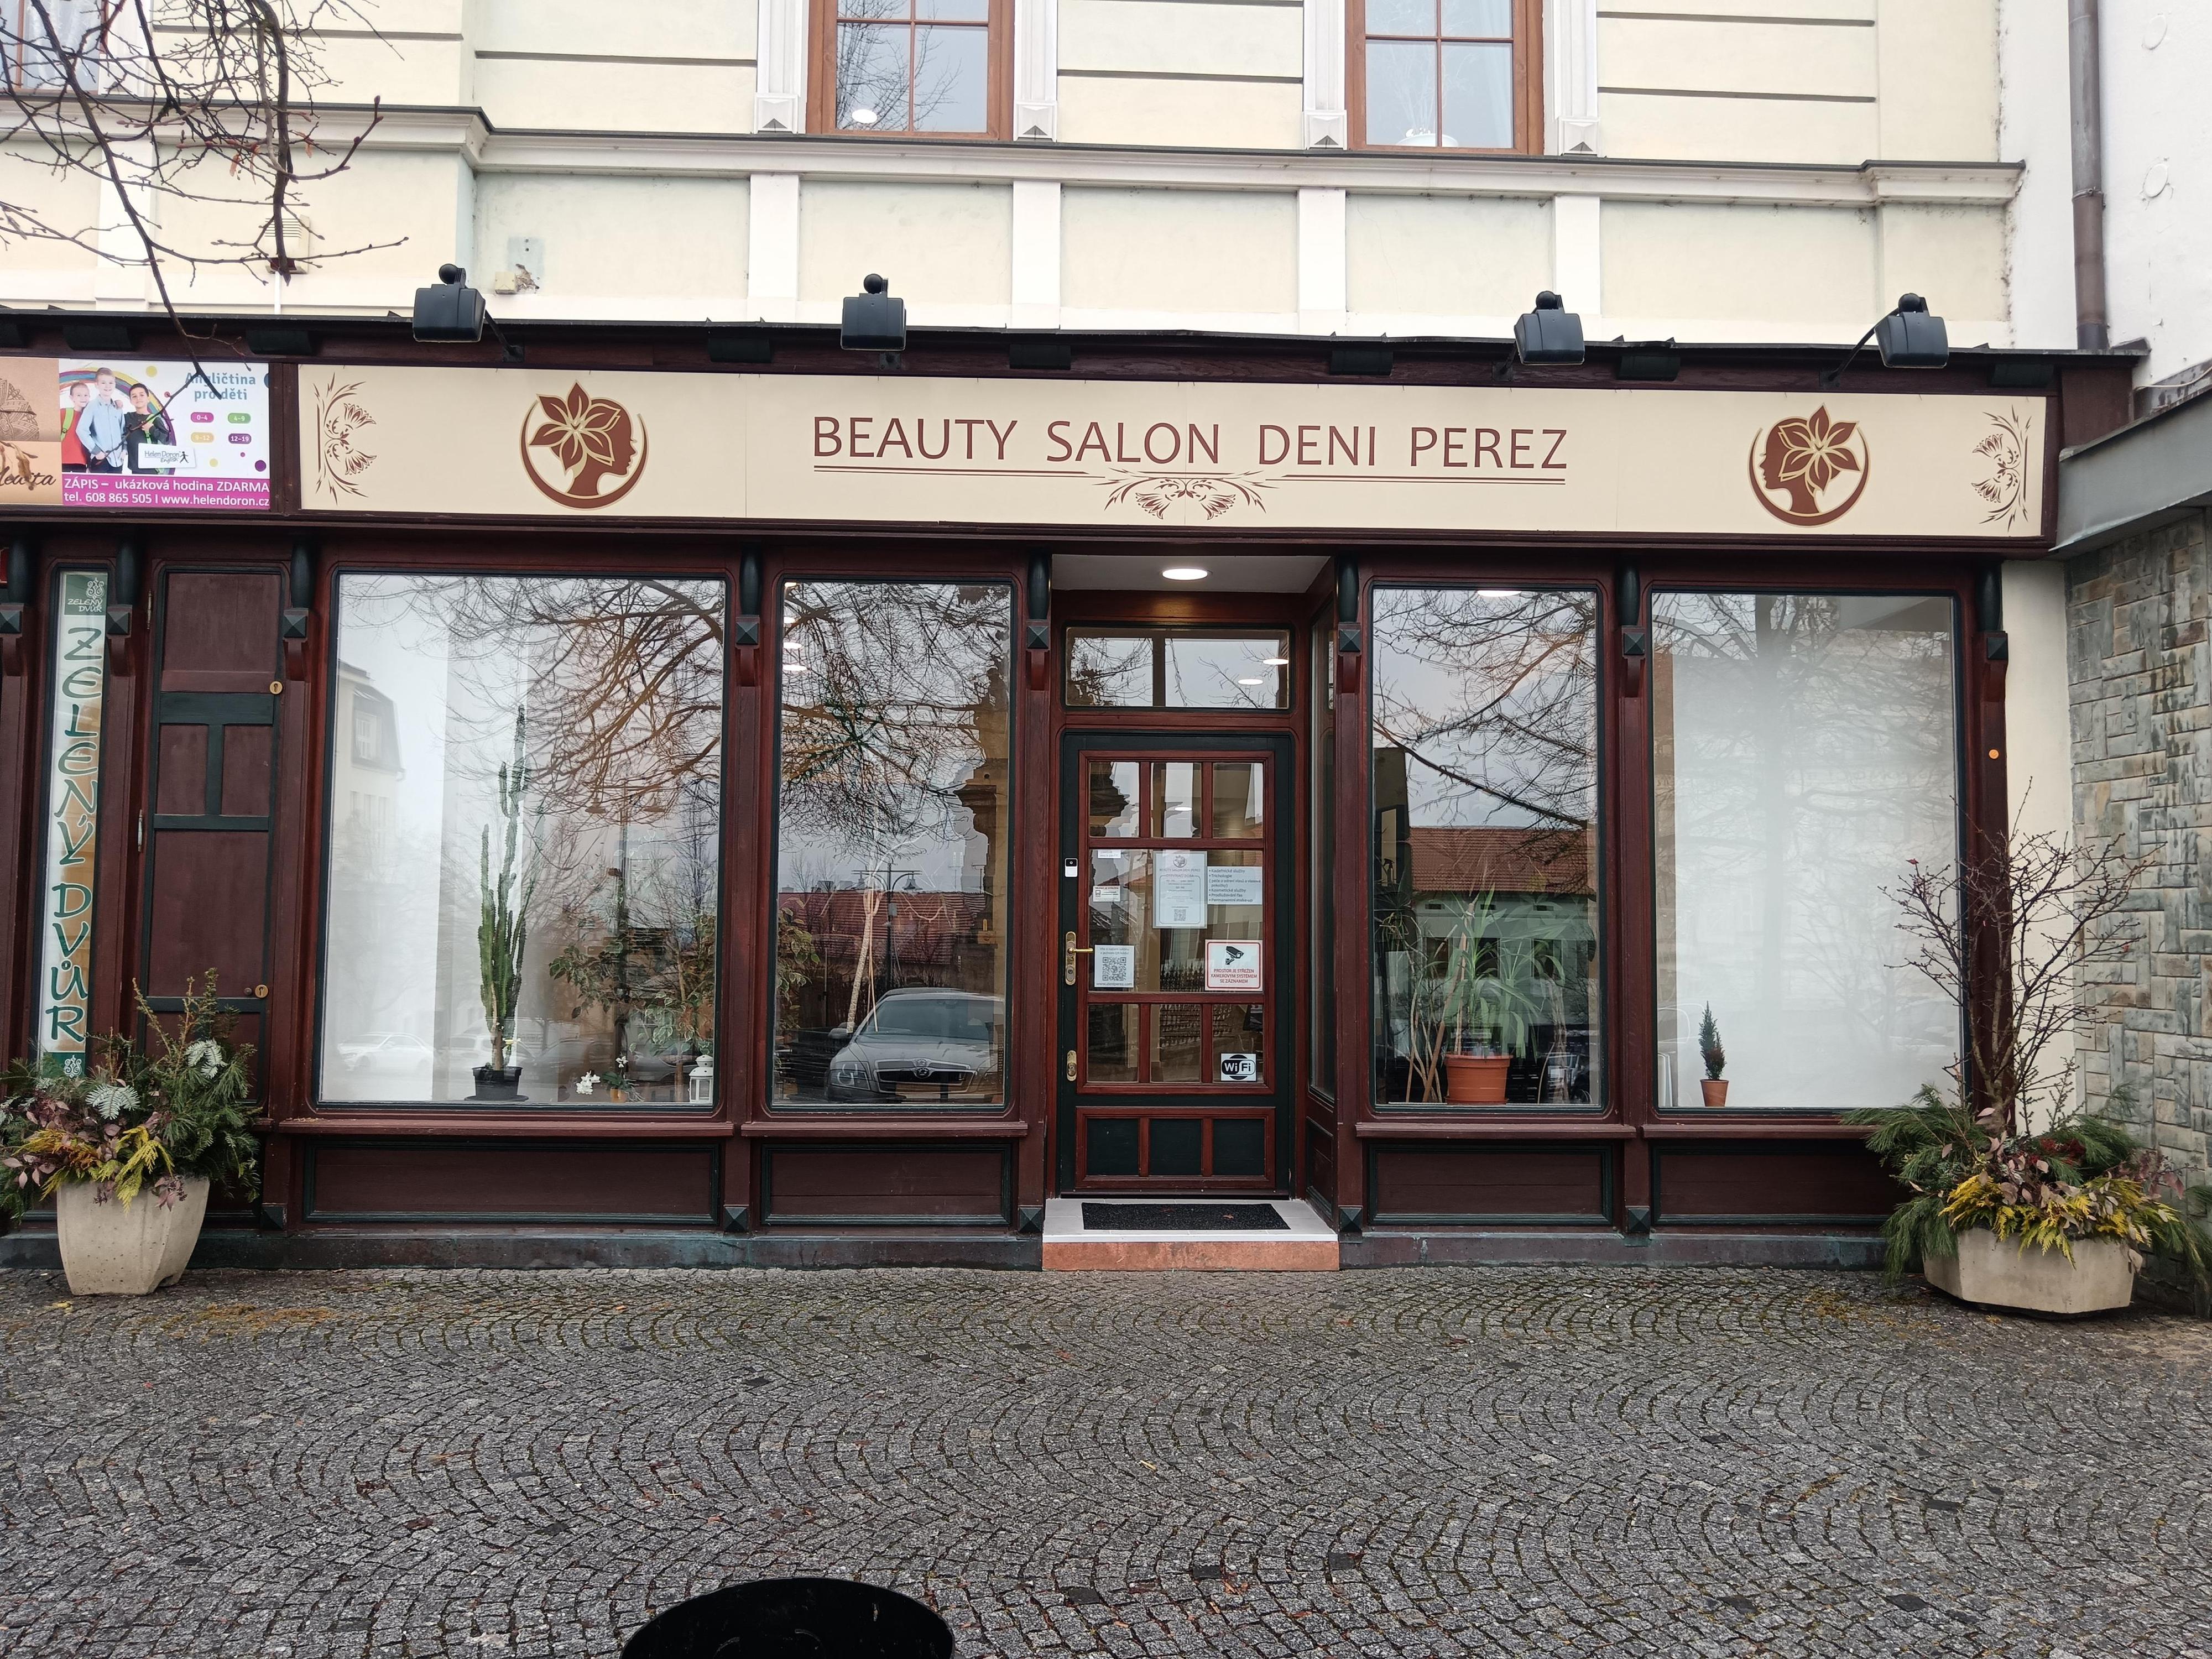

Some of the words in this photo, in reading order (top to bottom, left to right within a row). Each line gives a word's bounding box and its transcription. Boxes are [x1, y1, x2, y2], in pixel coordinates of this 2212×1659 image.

[221, 388, 247, 400] děti
[813, 416, 1019, 460] BEAUTY
[1046, 420, 1219, 464] SALON
[1259, 424, 1376, 466] DENI
[1410, 426, 1567, 469] PEREZ
[64, 476, 98, 489] ZÁPIS
[115, 479, 169, 490] ukázková
[173, 480, 213, 491] hodina
[217, 481, 270, 492] ZDARMA
[64, 492, 82, 502] tel.
[85, 493, 106, 502] 608
[108, 493, 128, 503] 865
[132, 493, 152, 503] 505
[161, 494, 269, 506] www.helendoron.cz
[67, 598, 103, 607] ZELENÝ
[54, 627, 103, 866] ZELENÝ
[45, 883, 92, 1043] DVŮR
